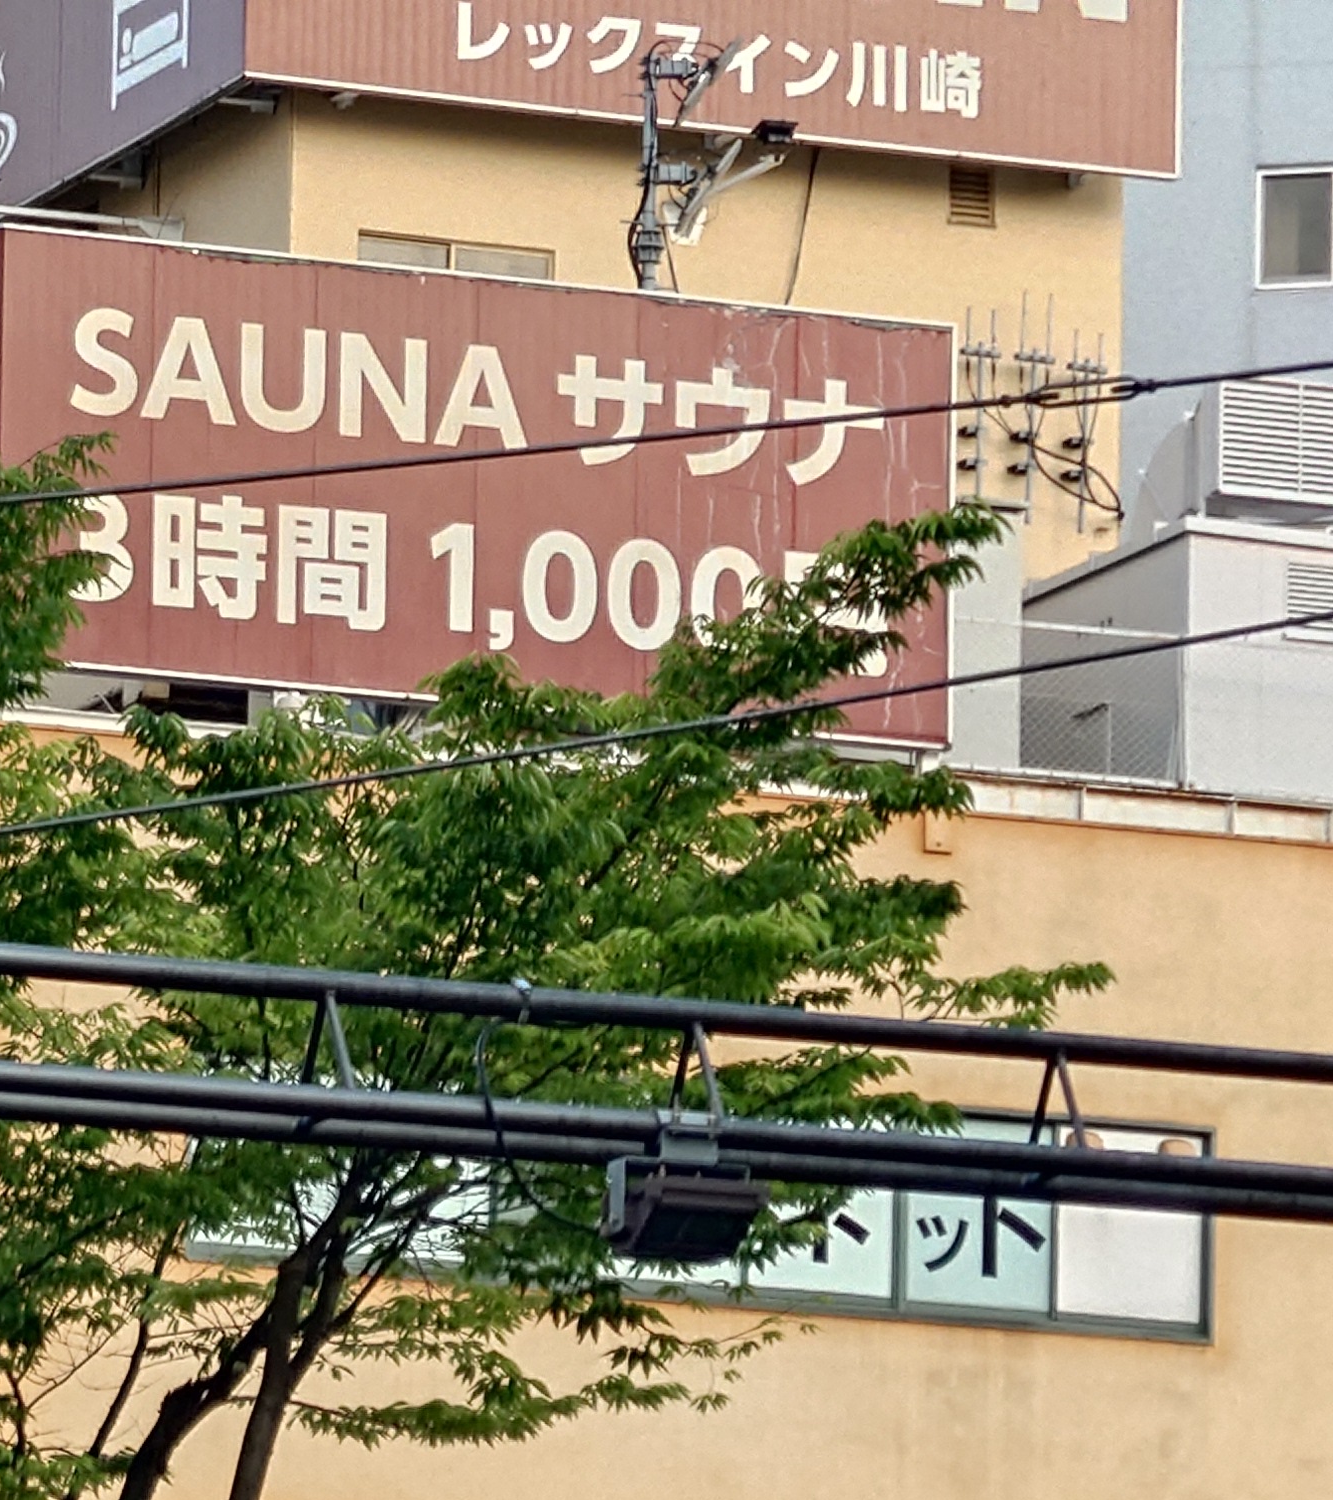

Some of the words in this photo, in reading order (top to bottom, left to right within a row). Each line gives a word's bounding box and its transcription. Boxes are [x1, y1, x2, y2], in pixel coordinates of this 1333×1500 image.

[69, 307, 529, 449] SAUNA
[557, 352, 886, 486] サウナ
[67, 492, 388, 632] 3時間
